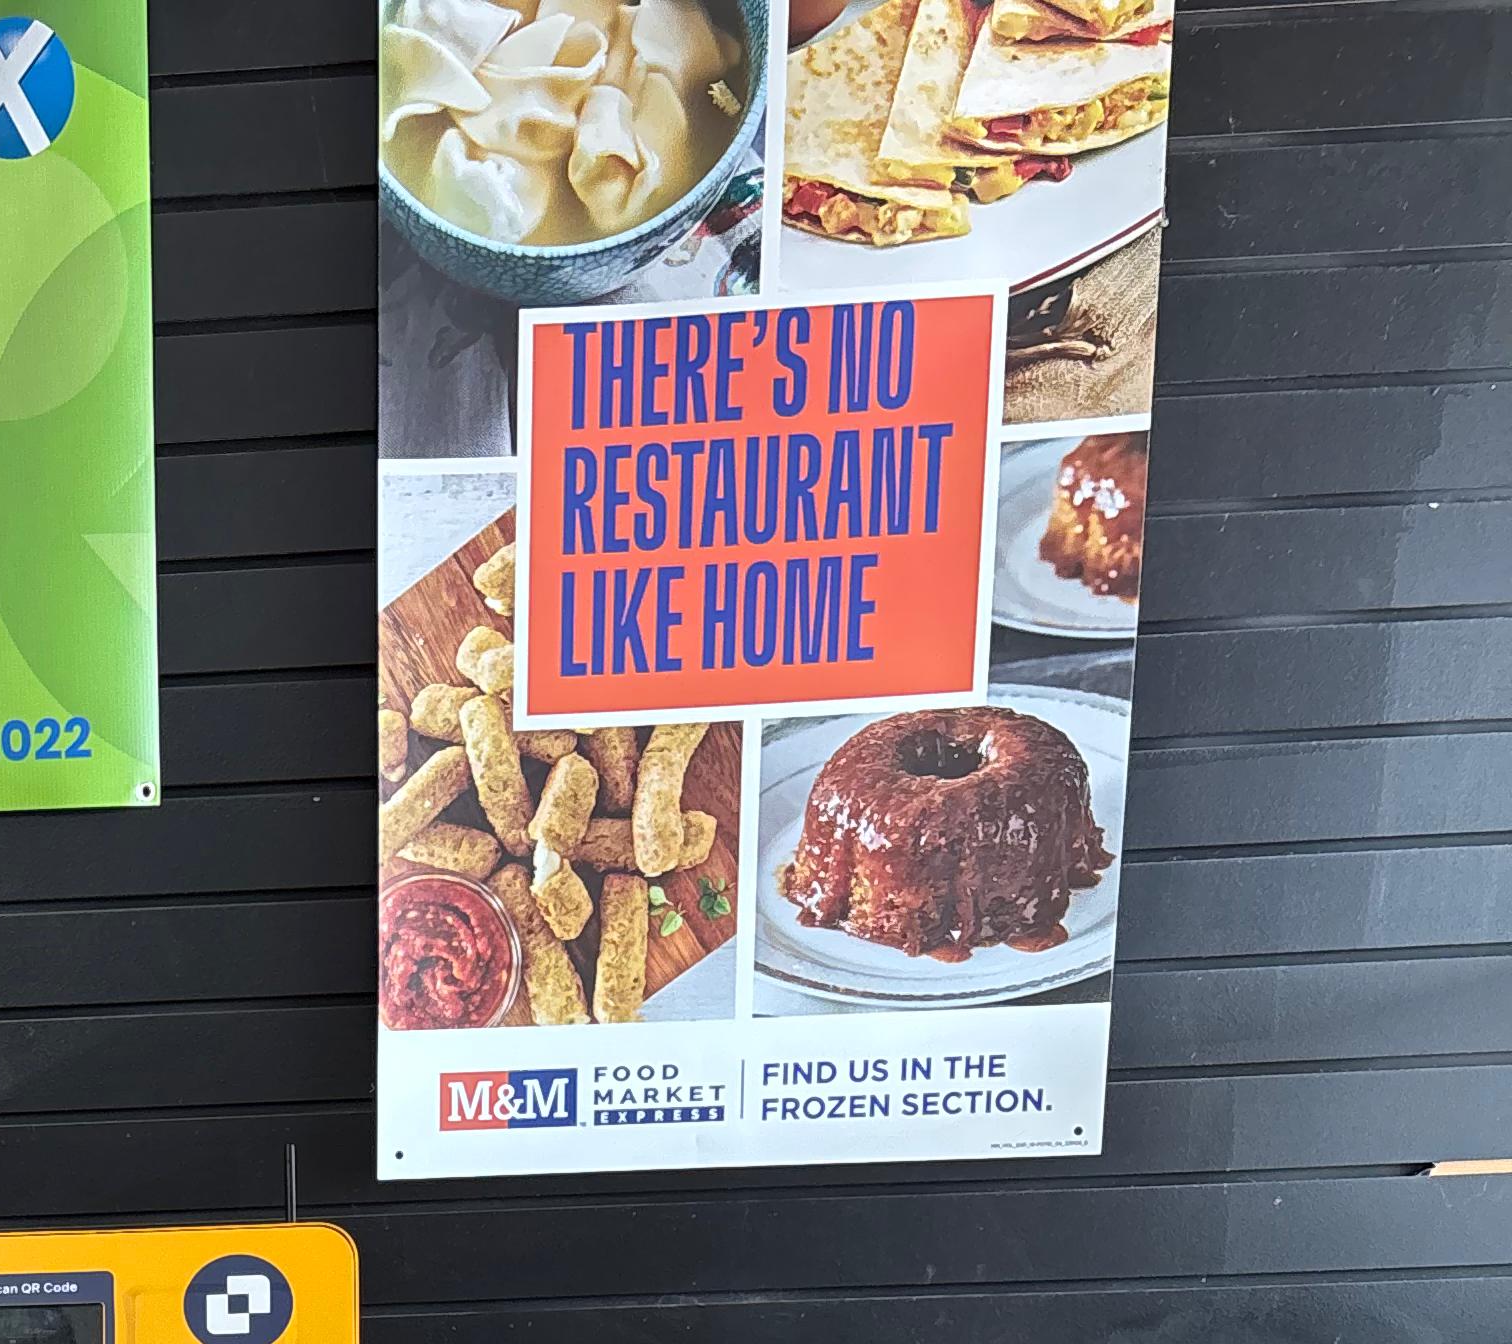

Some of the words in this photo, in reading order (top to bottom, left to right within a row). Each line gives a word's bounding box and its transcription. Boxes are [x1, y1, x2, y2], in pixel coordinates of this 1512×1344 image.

[563, 307, 809, 430] THERE'S
[828, 300, 915, 413] NO
[562, 423, 953, 556] RESTAURANT
[559, 566, 683, 678] LIKE
[701, 554, 878, 669] HOME
[594, 1064, 679, 1082] FOOD
[763, 1061, 834, 1085] FIND
[849, 1059, 887, 1082] US
[900, 1057, 932, 1080] IN
[944, 1054, 1006, 1079] THE
[448, 1077, 569, 1121] M&M
[594, 1085, 725, 1105] MARKET
[763, 1094, 887, 1121] FROZEN
[901, 1088, 1051, 1118] SECTION.
[600, 1109, 719, 1123] EXPRESS
[21, 1282, 41, 1295] QR
[44, 1280, 78, 1294] Code
